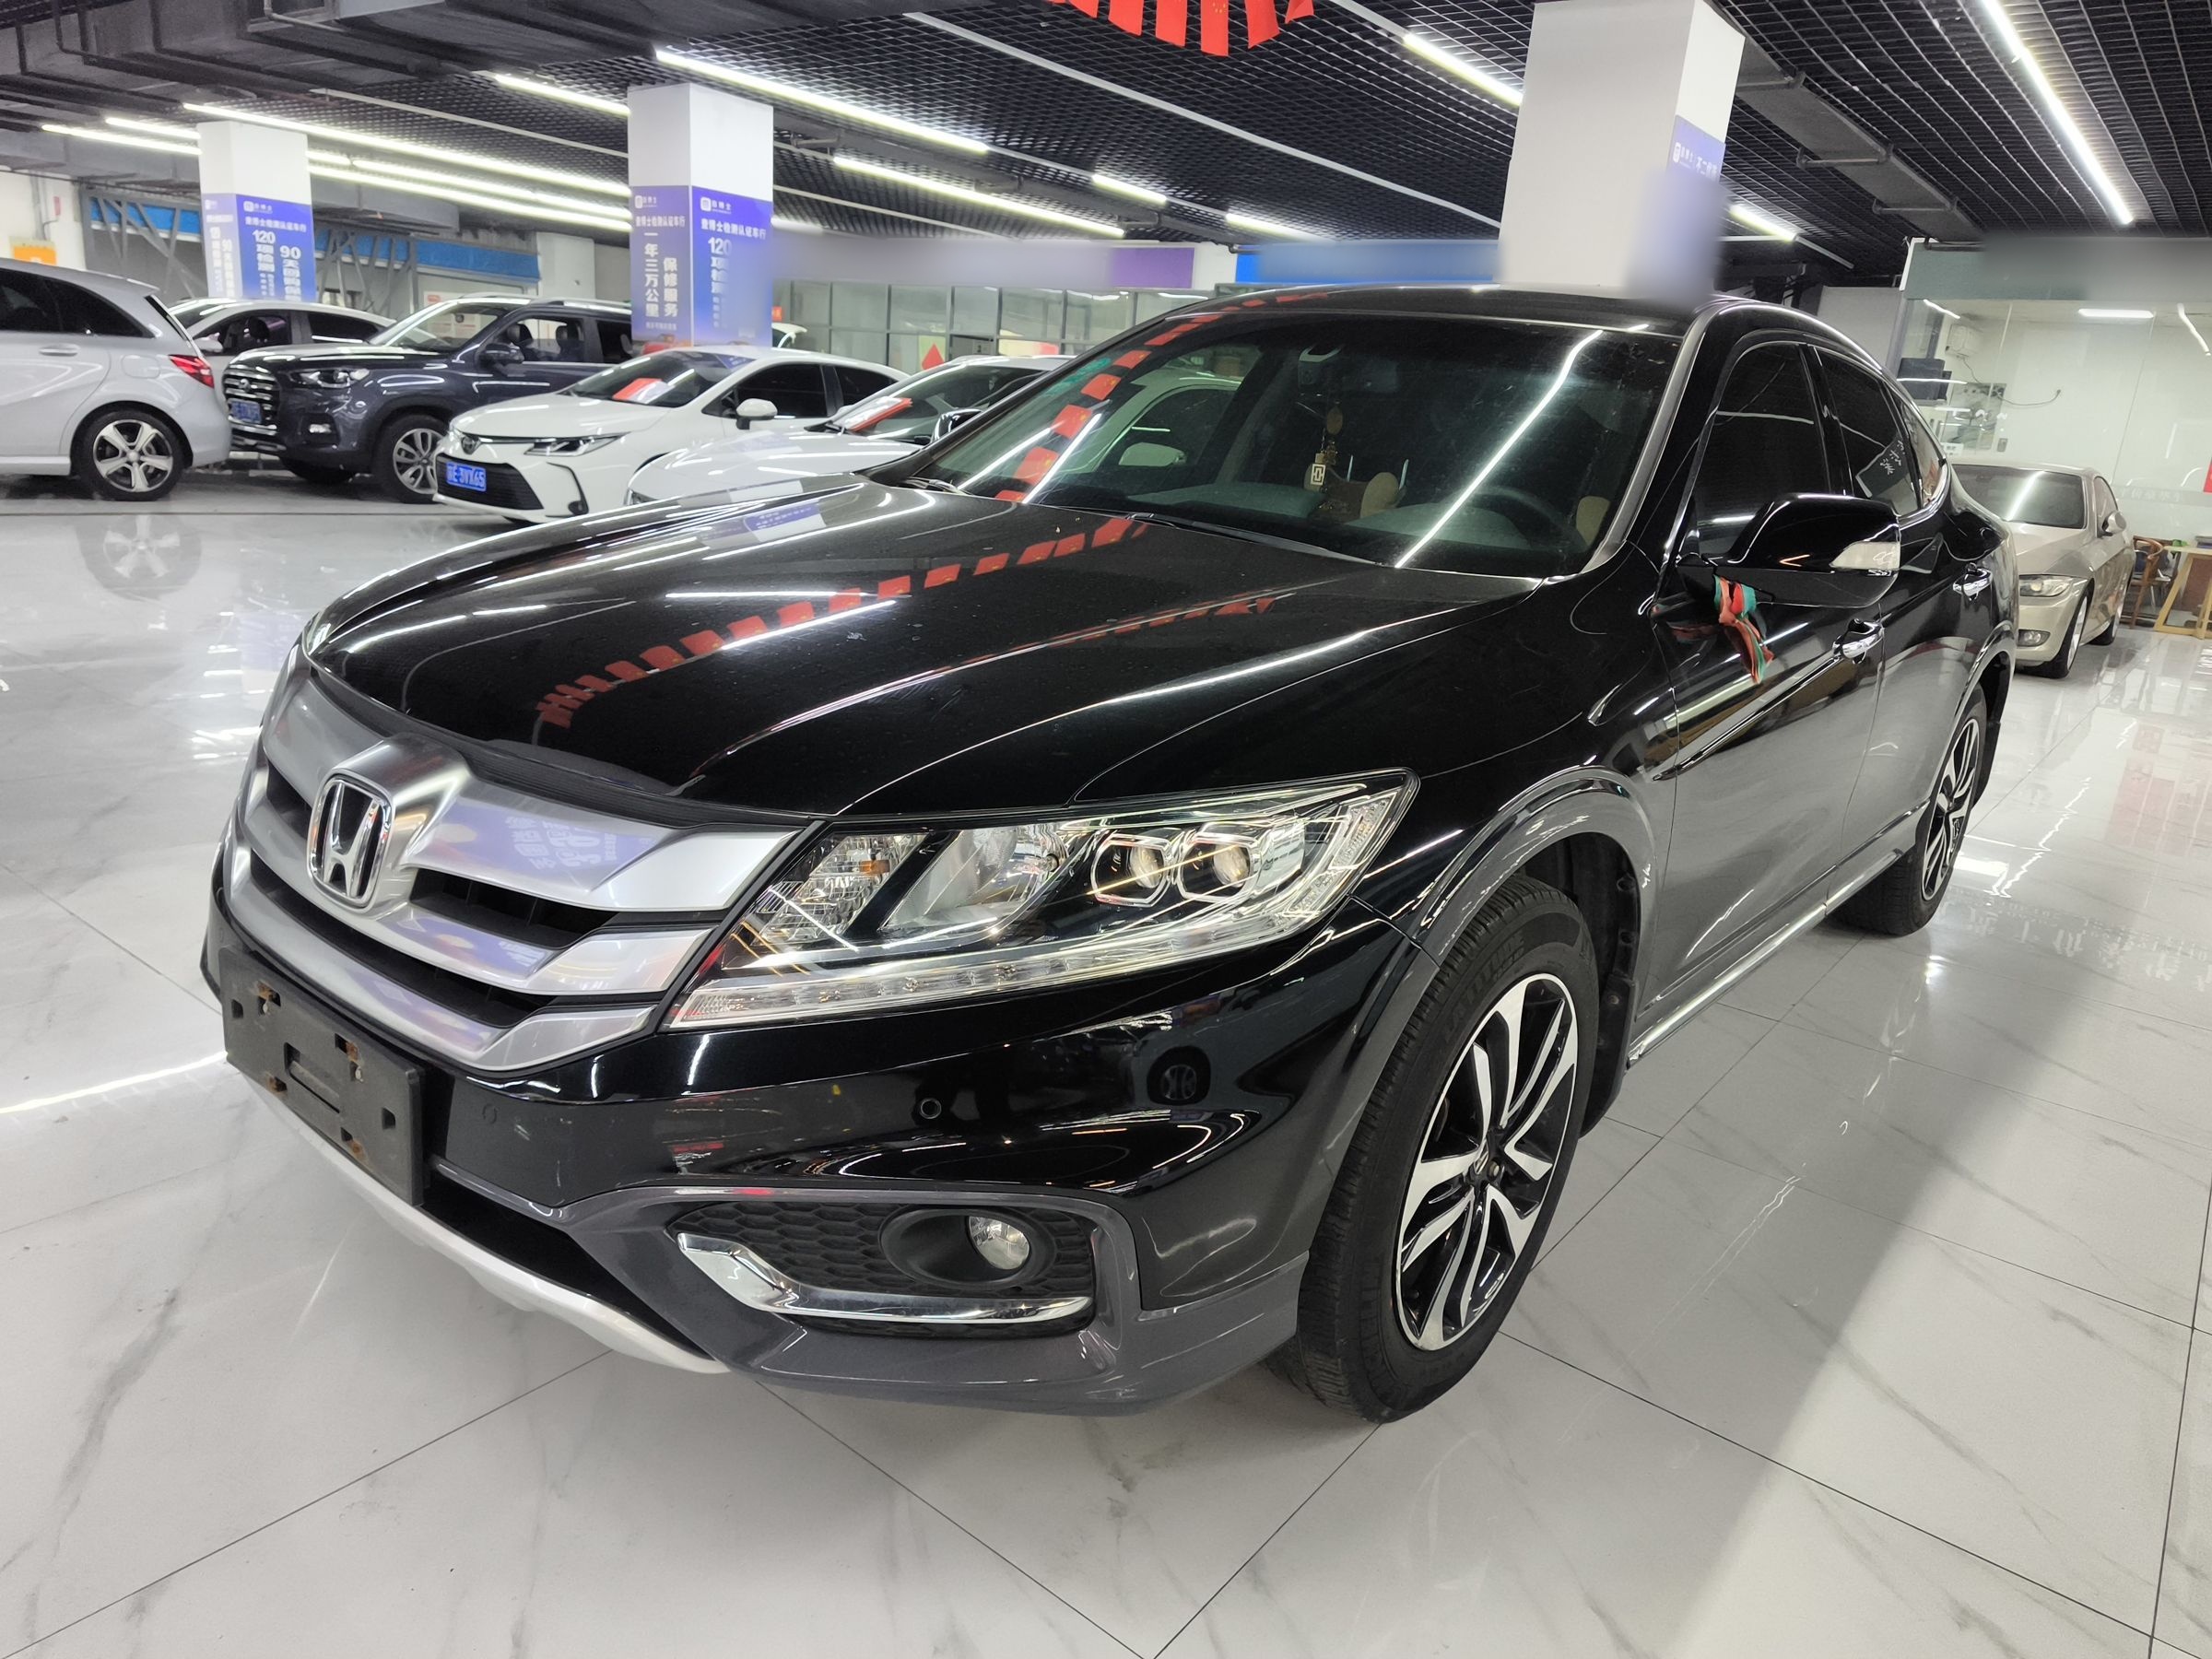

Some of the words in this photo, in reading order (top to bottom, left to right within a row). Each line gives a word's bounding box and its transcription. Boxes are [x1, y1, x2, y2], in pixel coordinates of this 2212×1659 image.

[644, 232, 660, 317] 一年三万公里
[664, 257, 678, 317] 保修服务
